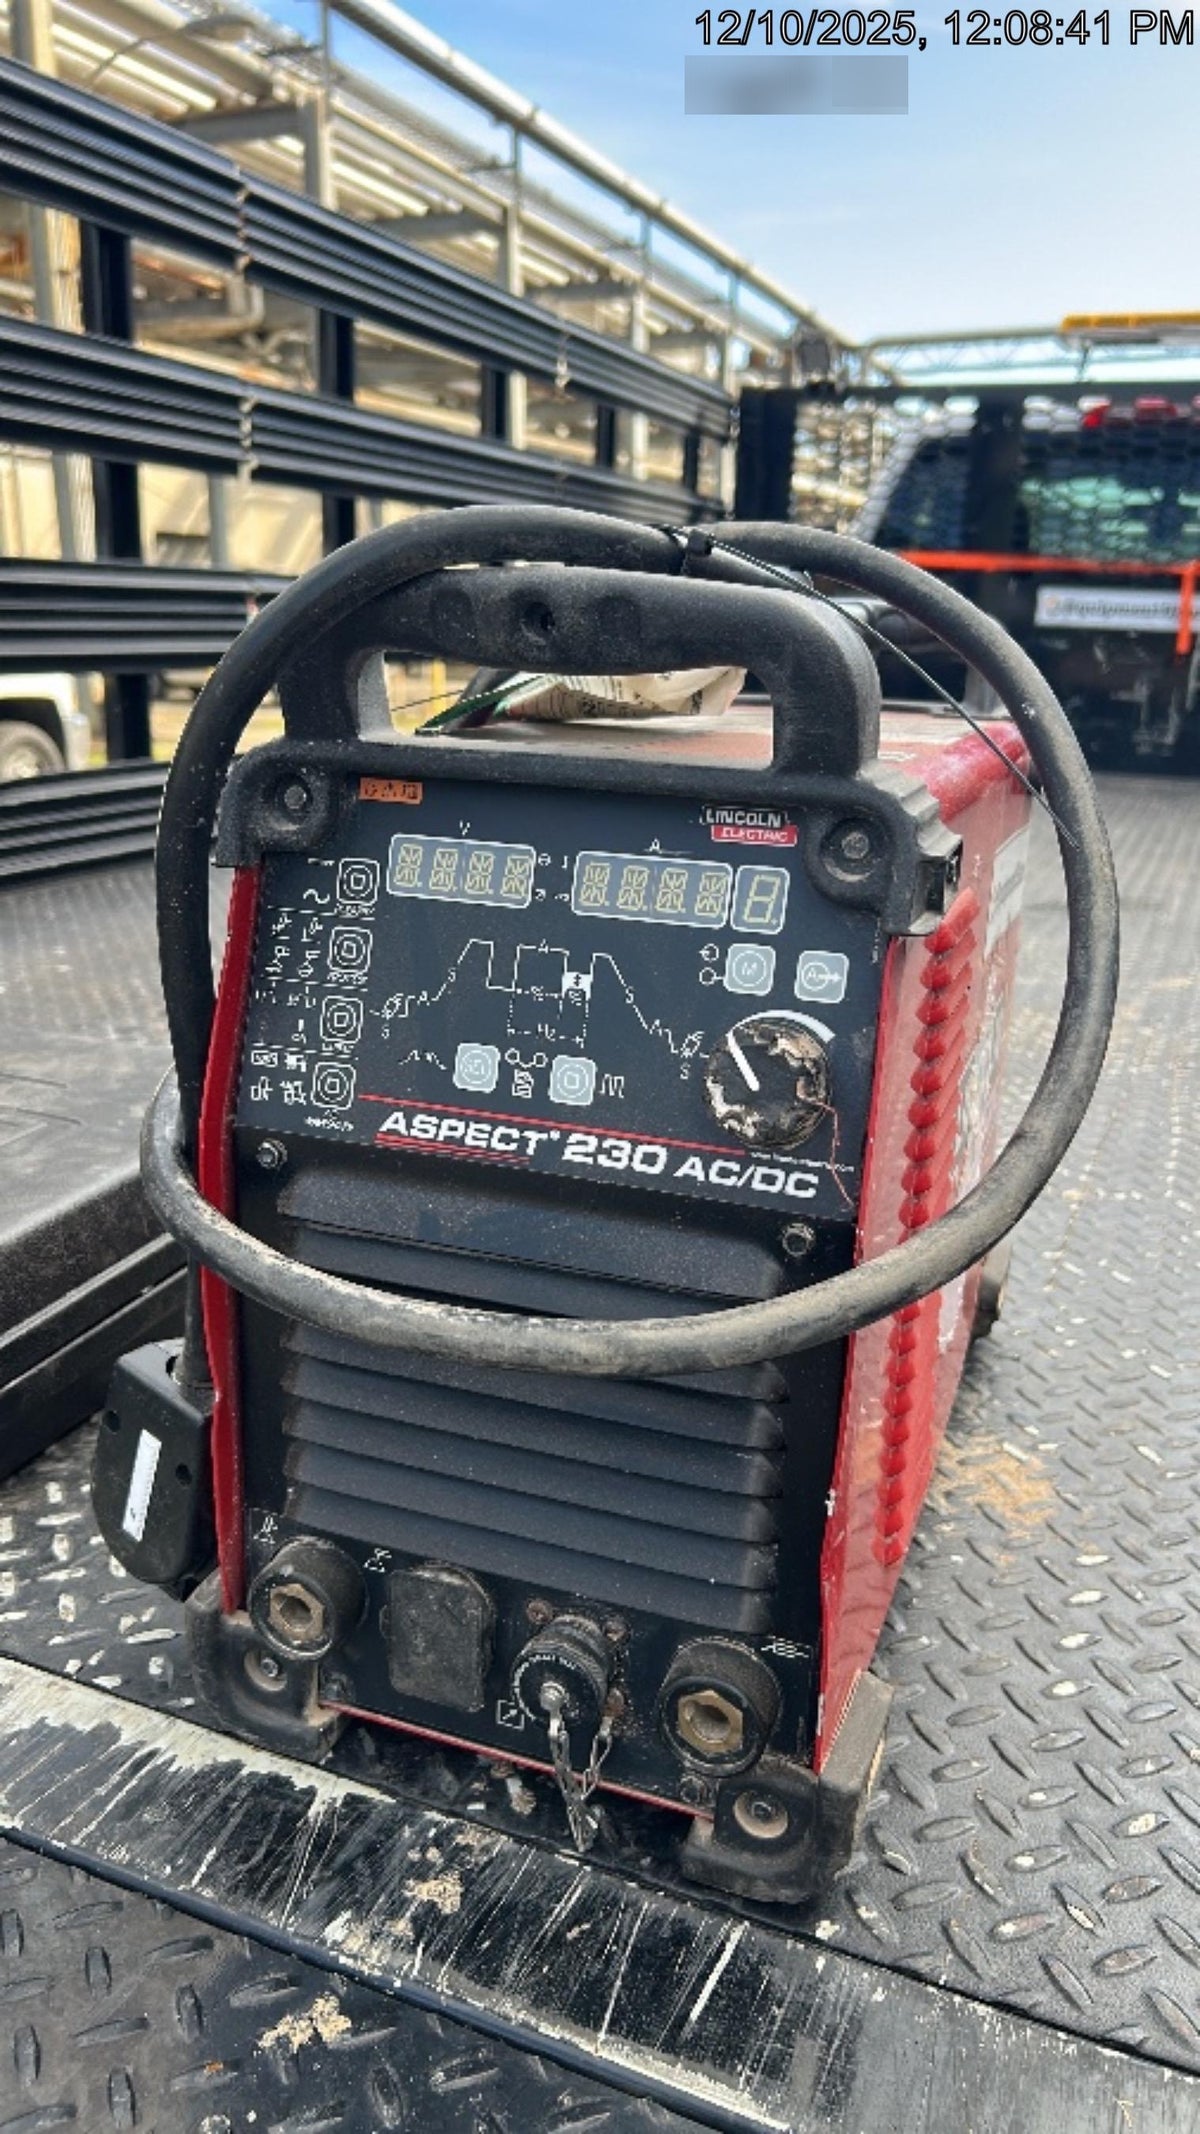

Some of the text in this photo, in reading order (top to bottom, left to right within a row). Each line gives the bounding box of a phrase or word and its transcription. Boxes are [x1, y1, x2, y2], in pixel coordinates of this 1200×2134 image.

[706, 808, 781, 828] LINCOLN
[722, 827, 788, 843] ELECTRIC
[562, 1133, 667, 1174] 230
[673, 1157, 820, 1198] AC/DC
